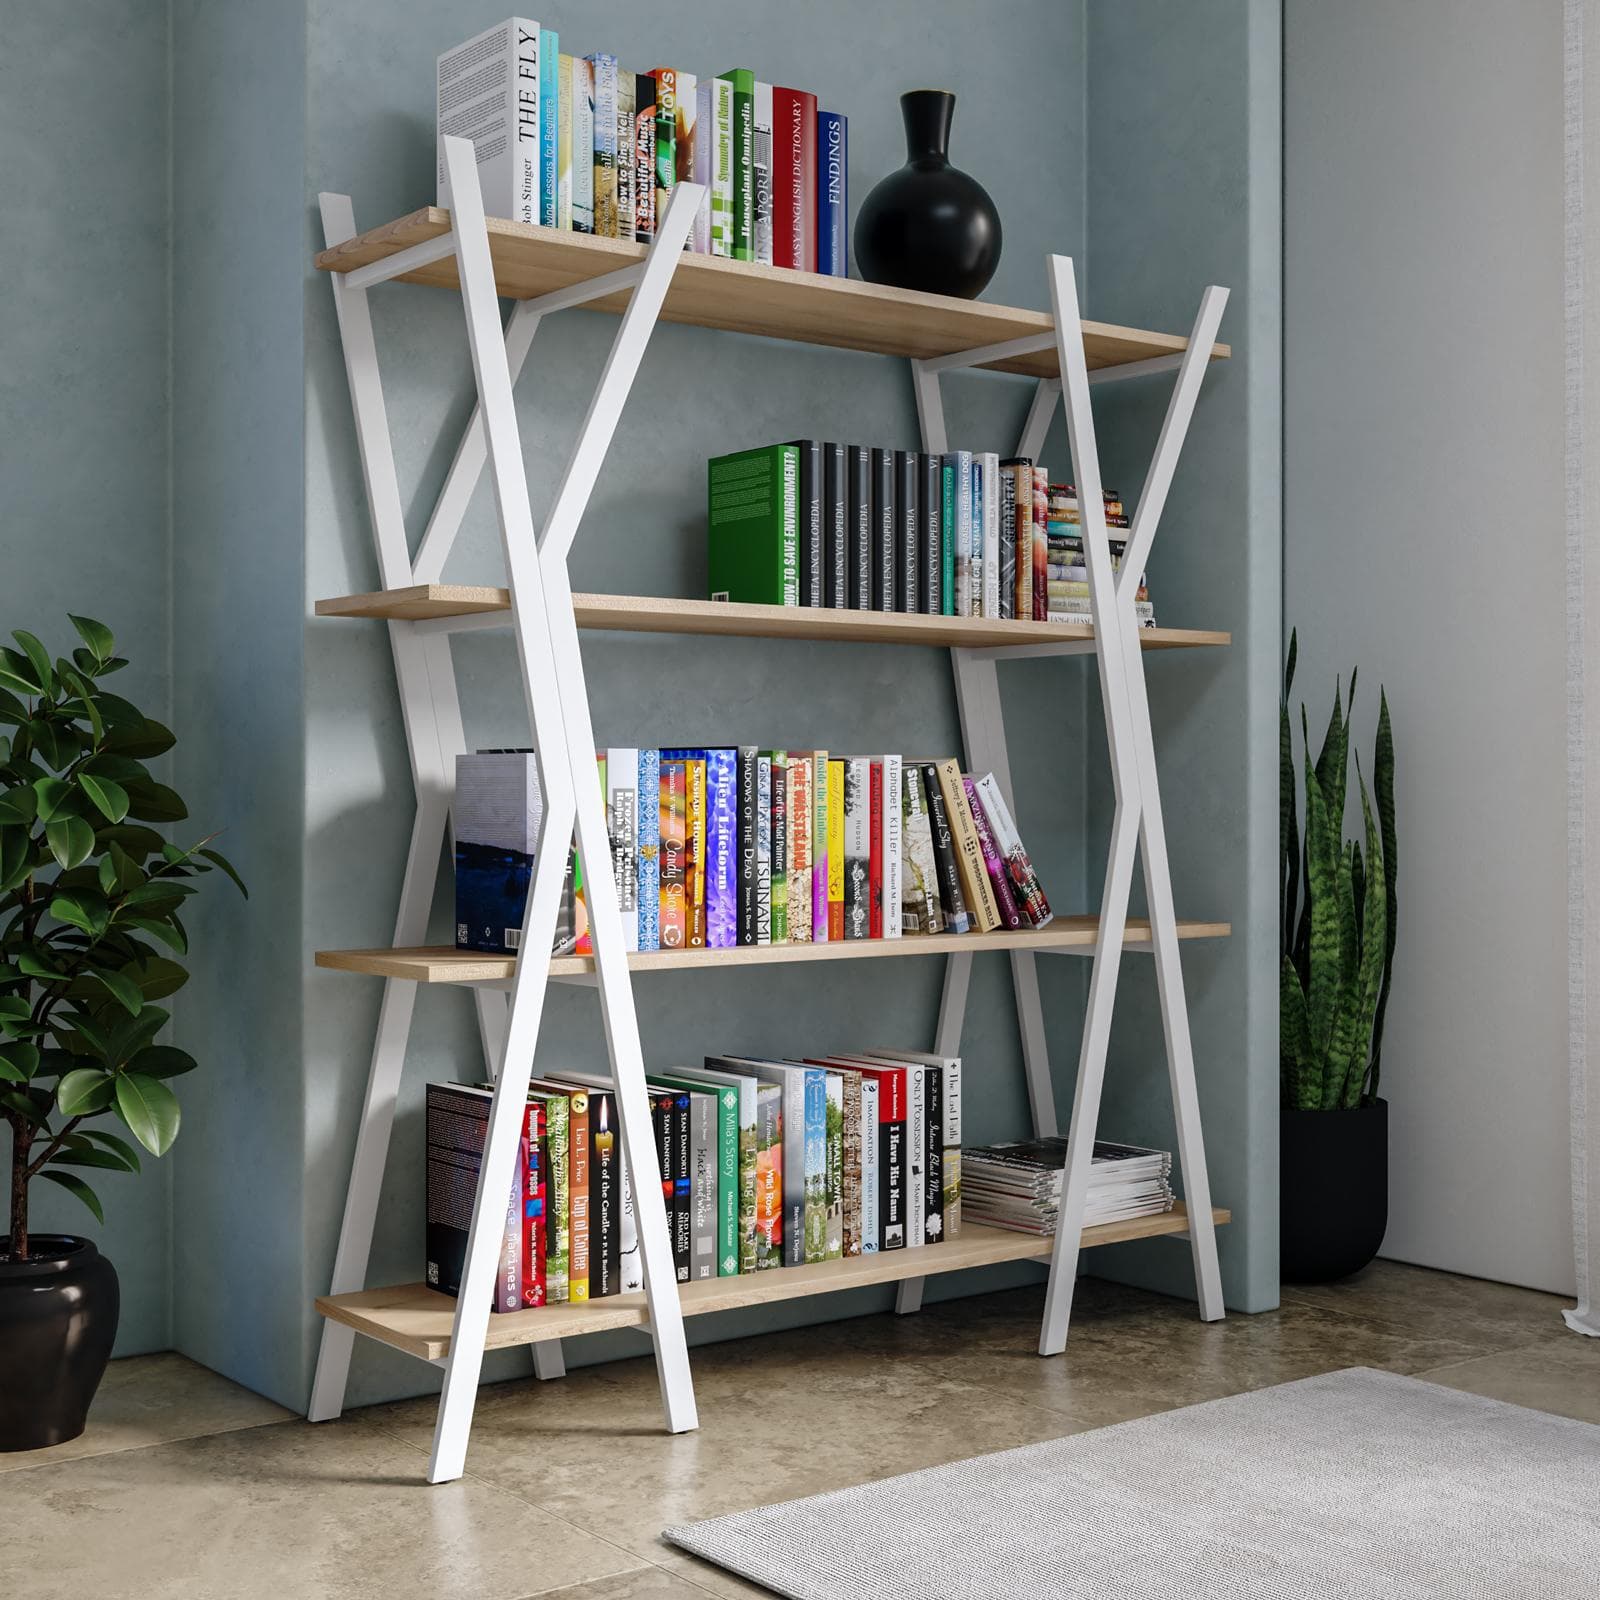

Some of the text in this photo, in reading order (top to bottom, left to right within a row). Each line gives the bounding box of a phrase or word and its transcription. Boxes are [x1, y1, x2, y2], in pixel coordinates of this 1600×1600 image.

[519, 27, 537, 142] THE FLY
[602, 93, 612, 113] the
[659, 71, 674, 119] TOYS
[602, 117, 612, 127] in
[717, 86, 729, 182] Symmetry of Nature
[544, 99, 553, 199] Lessons for Beginers
[602, 133, 613, 181] Walking
[618, 111, 629, 212] How to Sing Well
[637, 115, 649, 217] Beautiful Music
[741, 102, 752, 237] Houseplant Omnipedia
[828, 121, 841, 204] FINDINGS
[522, 158, 533, 200] Stinger
[792, 99, 801, 267] EASY ENGLISH DICTIONARY
[860, 451, 868, 462] III
[883, 455, 892, 466] IV
[906, 457, 914, 465] V
[930, 458, 938, 469] VI
[961, 454, 969, 473] DOG
[961, 475, 969, 511] HEALTHY
[784, 452, 796, 607] HOW TO SAVE ENVINRONMENT?
[811, 499, 819, 607] THETA ENCYCLOPEDIA
[836, 501, 844, 609] THETA ENCYCLOPEDIA
[972, 519, 980, 546] SHAPE
[972, 550, 980, 558] IN
[860, 504, 868, 610] THETA ENCYCLOPEDIA
[883, 506, 892, 612] THETA ENCYCLOPEDIA
[906, 508, 914, 613] THETA ENCYCLOPEDIA
[930, 510, 938, 615] THETA ENCYCLOPEDIA
[972, 579, 980, 598] AND
[615, 792, 624, 826] Ralph
[692, 767, 701, 816] SUNSHADE
[718, 763, 729, 808] Alien
[759, 762, 768, 845] GINA P. PAYTON
[816, 755, 827, 845] Inside the Rainbow
[887, 759, 898, 855] Alphabet Killer
[907, 769, 922, 821] Stonewall
[616, 830, 624, 843] M.
[744, 750, 754, 879] SHADOWS OF THE DEAD
[776, 780, 784, 870] Life of the Mad Painter
[793, 762, 807, 871] THE WASTELAND
[931, 792, 950, 849] Inverted Sky
[624, 792, 634, 909] Frozen Prisoner
[693, 820, 701, 864] HOLIDAY
[718, 815, 729, 891] Lifeform
[662, 838, 683, 919] Candy Shore
[757, 857, 770, 941] TSUNAMI
[949, 1073, 958, 1090] The
[949, 1095, 958, 1114] Last
[913, 1070, 923, 1162] ONLY POSSESSION
[929, 1120, 939, 1150] Intense
[528, 1110, 539, 1195] bouquet of red roses
[576, 1128, 585, 1183] Lisa L. Price
[696, 1148, 707, 1177] black
[724, 1113, 736, 1177] Mila's Story
[890, 1134, 899, 1163] Have
[929, 1153, 939, 1178] Black
[555, 1167, 564, 1184] the
[601, 1148, 609, 1234] Life of the Candle
[705, 1163, 714, 1211] nothing is
[745, 1148, 756, 1198] Living
[833, 1169, 841, 1204] TOWN
[890, 1166, 899, 1186] His
[928, 1180, 939, 1206] Magic
[552, 1188, 564, 1217] Alley
[696, 1200, 706, 1229] white
[765, 1169, 774, 1250] Wild Rose Flower
[890, 1189, 899, 1222] Name
[574, 1196, 588, 1270] Cup of Coffee
[507, 1233, 517, 1291] Marines
